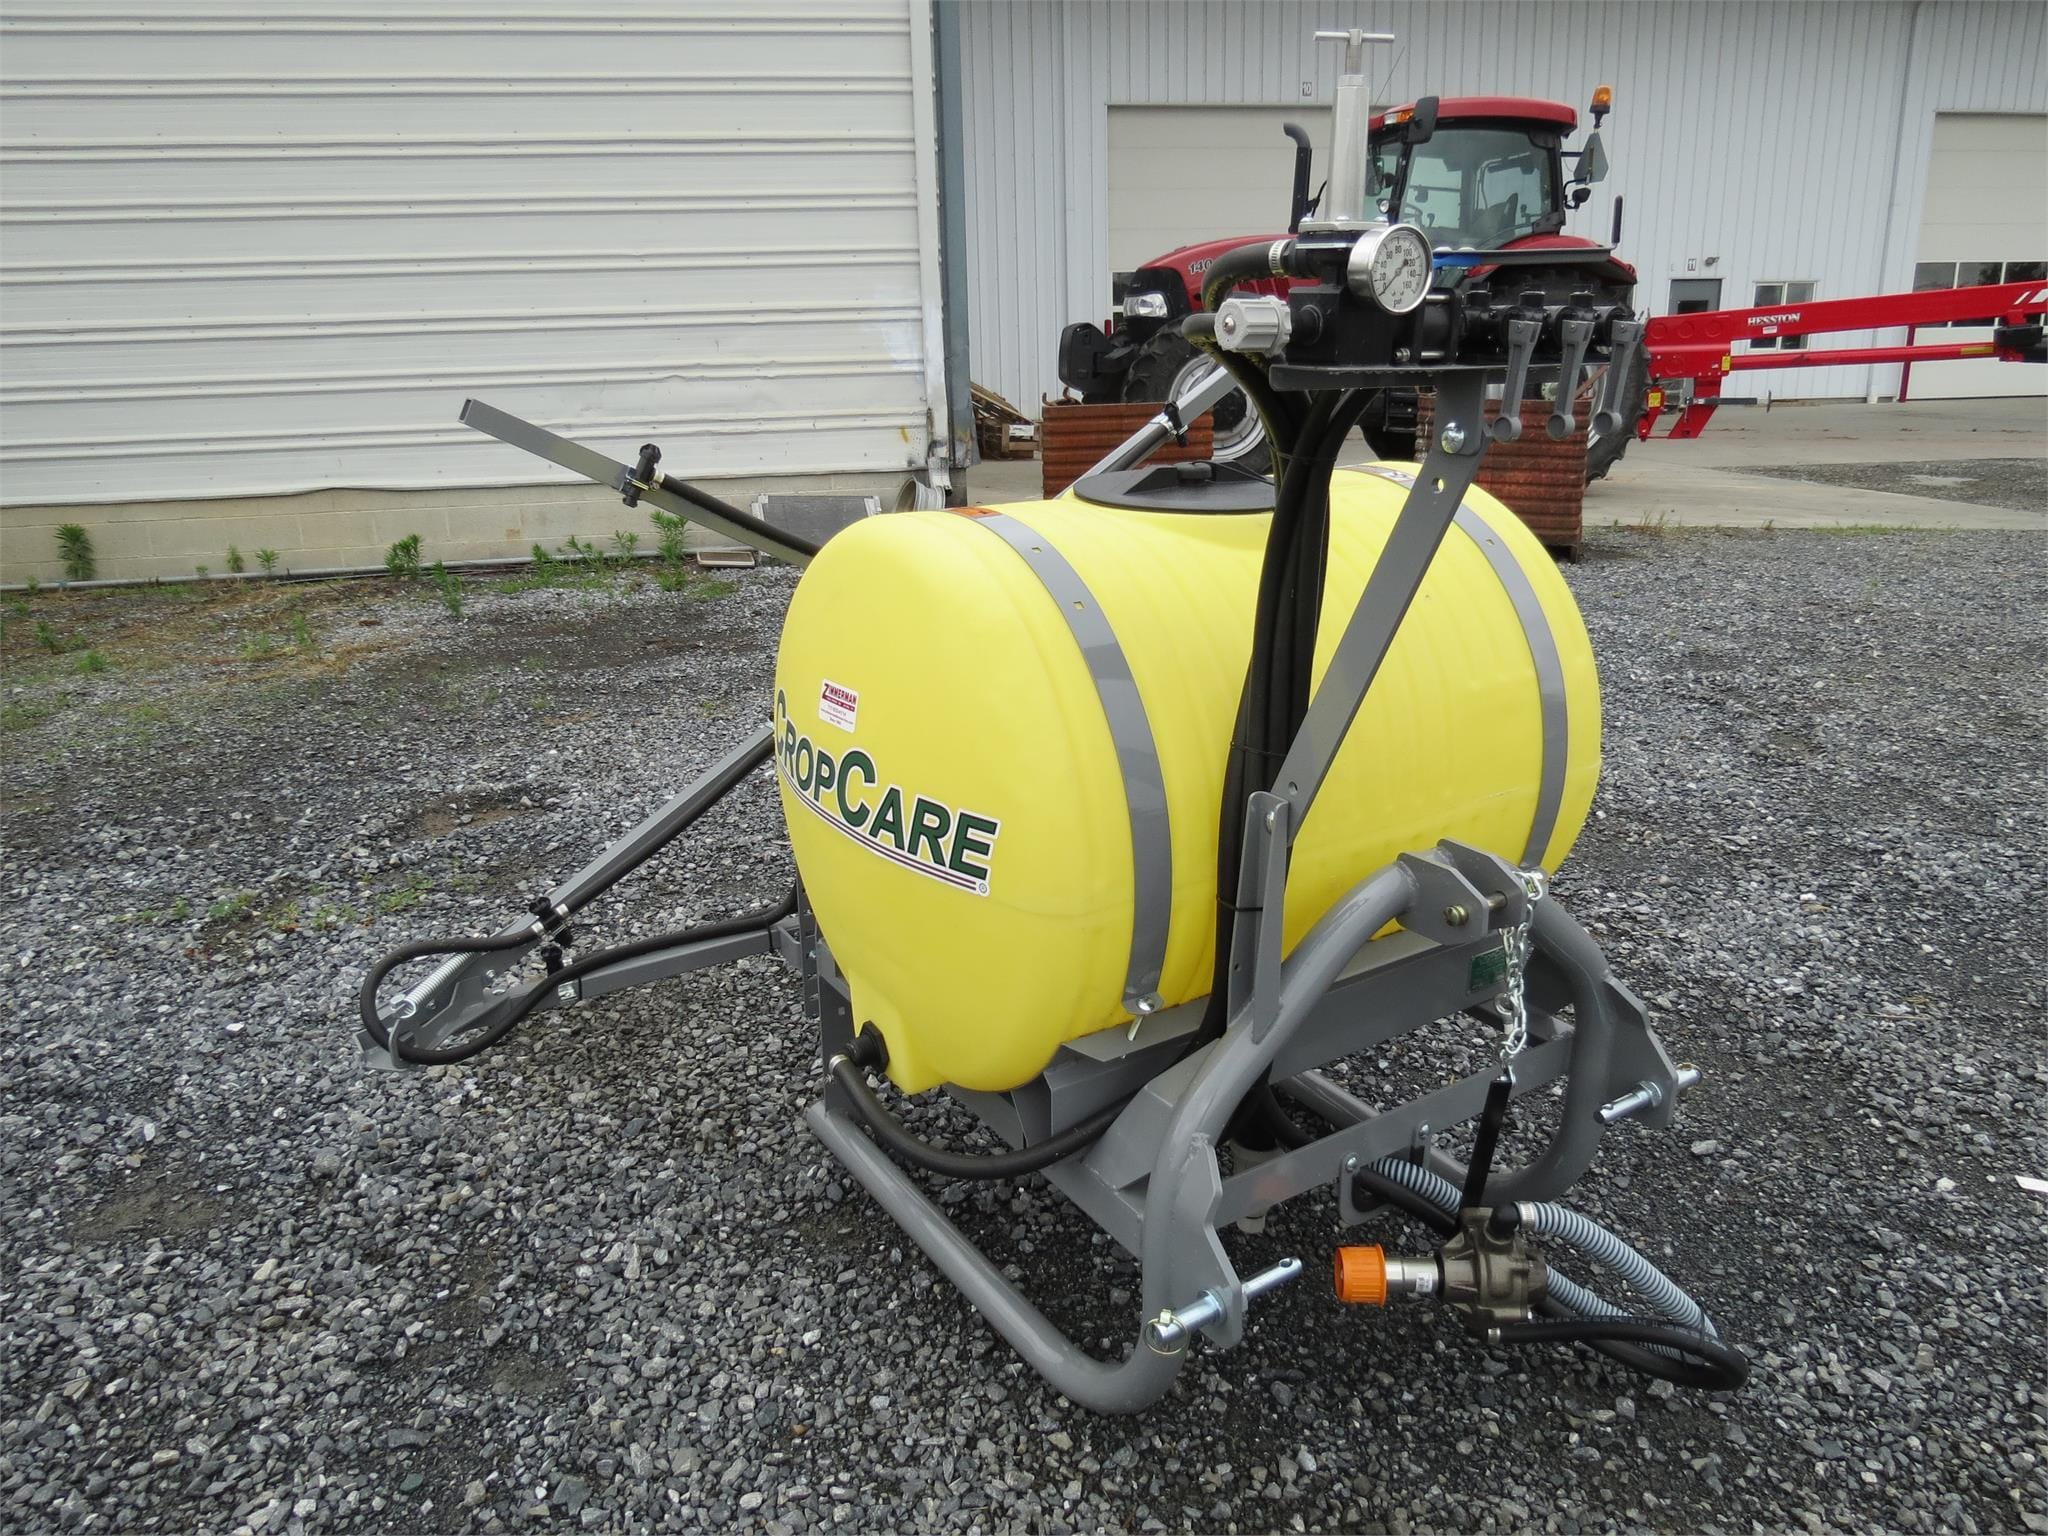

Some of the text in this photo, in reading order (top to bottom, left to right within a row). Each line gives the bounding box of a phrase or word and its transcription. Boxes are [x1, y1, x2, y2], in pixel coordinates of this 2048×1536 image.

[1403, 248, 1413, 257] 100
[1188, 258, 1214, 275] 140
[1747, 312, 1801, 326] HESSTON
[822, 683, 858, 704] ZIMMERMAN
